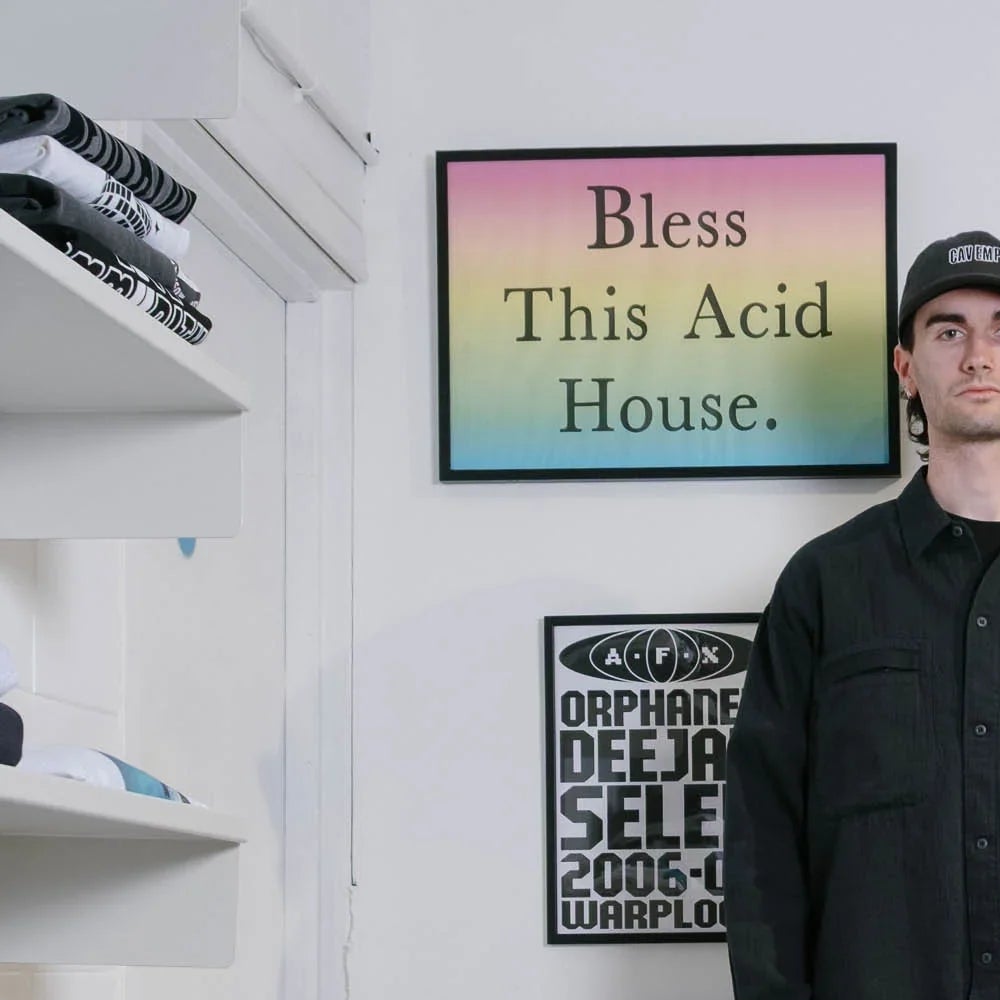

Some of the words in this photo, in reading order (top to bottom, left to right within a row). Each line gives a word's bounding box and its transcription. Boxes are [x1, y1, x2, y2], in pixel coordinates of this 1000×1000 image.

[587, 185, 747, 249] Bless
[948, 245, 973, 265] CAV
[504, 285, 648, 342] This
[683, 280, 833, 339] Acid
[559, 377, 777, 433] House.
[561, 688, 744, 727] ORPHANE
[560, 728, 728, 783] DEEJA
[560, 783, 725, 850] SELE
[561, 899, 726, 930] WARPLO
